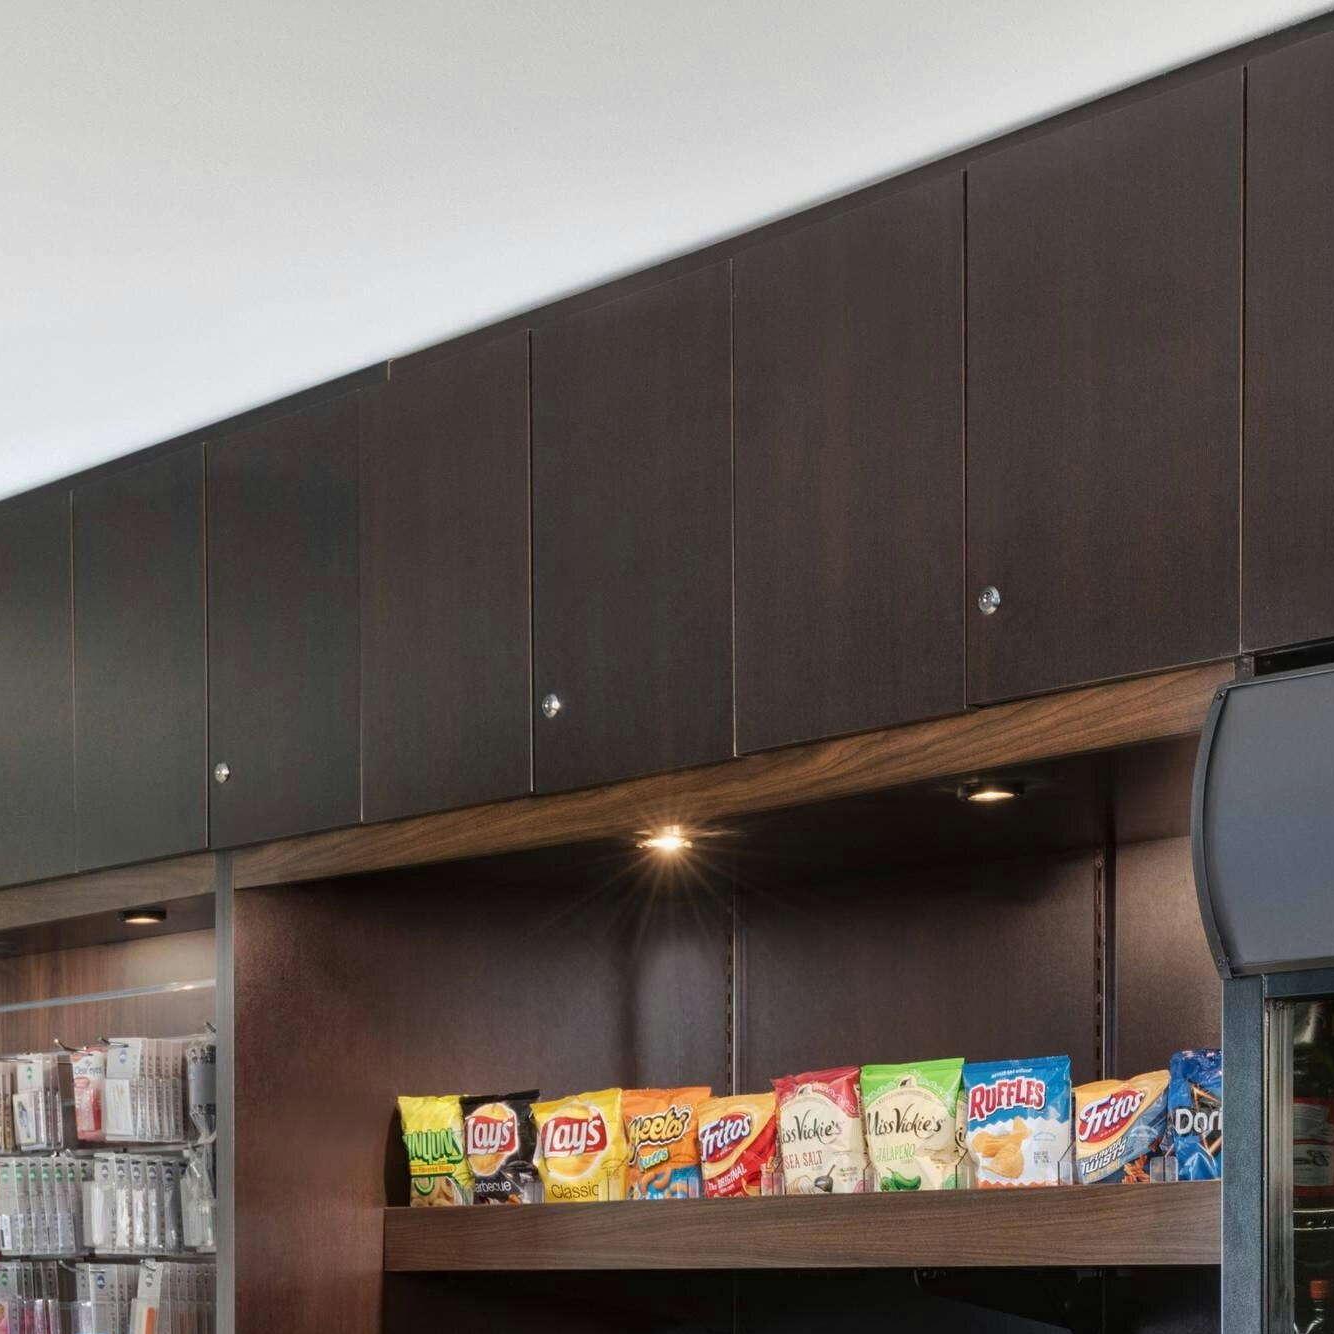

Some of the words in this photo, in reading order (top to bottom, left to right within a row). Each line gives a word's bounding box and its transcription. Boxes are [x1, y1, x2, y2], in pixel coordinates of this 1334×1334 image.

[968, 1077, 1047, 1122] RUFFLES
[1078, 1089, 1146, 1142] Fritos
[465, 1115, 513, 1155] Lay's
[544, 1108, 601, 1158] Lay's
[699, 1112, 752, 1157] Fritos
[793, 1109, 844, 1145] Vickie's
[893, 1103, 947, 1140] Vickie's
[1174, 1108, 1223, 1136] Dori
[717, 1165, 748, 1188] ORIGINAL
[784, 1153, 802, 1170] SEA
[803, 1150, 824, 1168] SALT
[473, 1180, 513, 1194] arbecue
[551, 1182, 599, 1199] Classic
